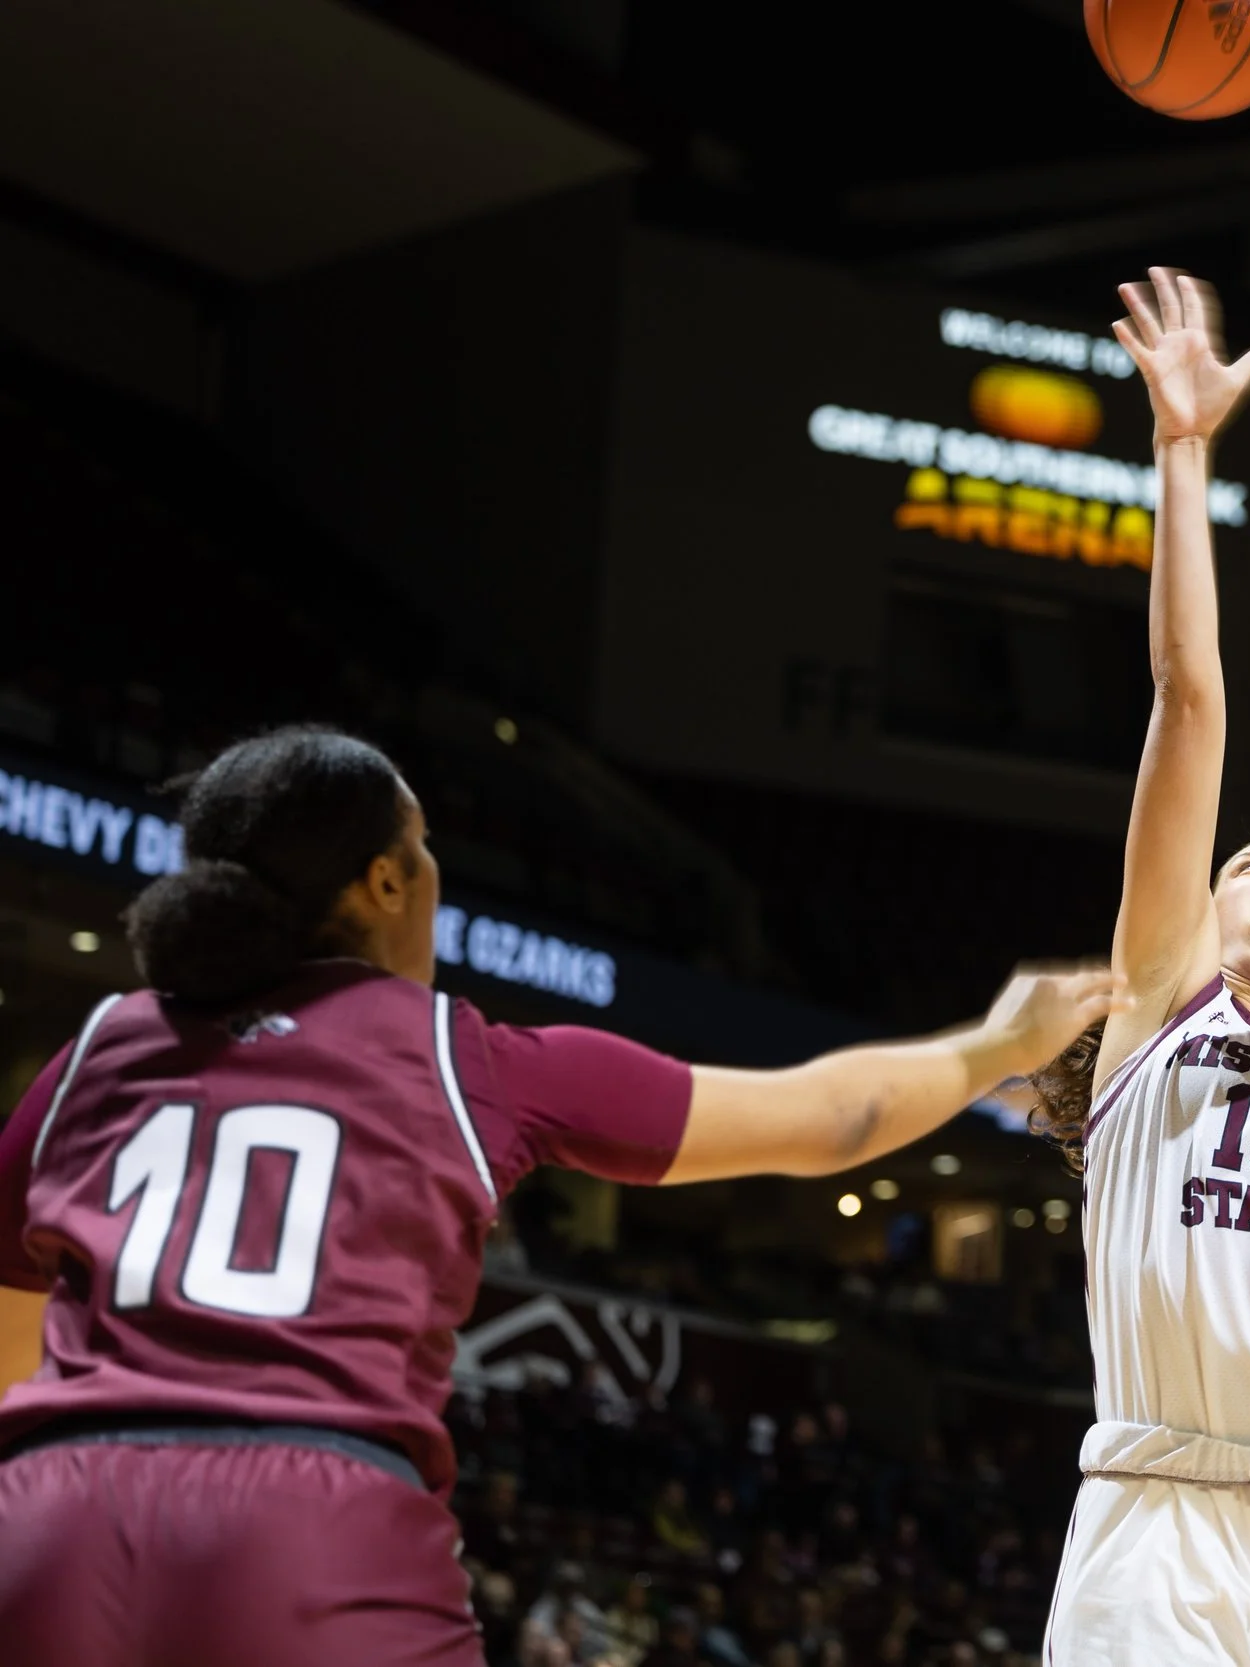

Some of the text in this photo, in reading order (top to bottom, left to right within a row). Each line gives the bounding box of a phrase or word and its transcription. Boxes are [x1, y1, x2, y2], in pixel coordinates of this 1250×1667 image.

[940, 307, 1092, 371] WELCOME
[808, 403, 942, 468] GREAT
[893, 467, 1156, 572] ARENA
[466, 915, 616, 1008] OZARKS
[105, 1100, 342, 1320] 10
